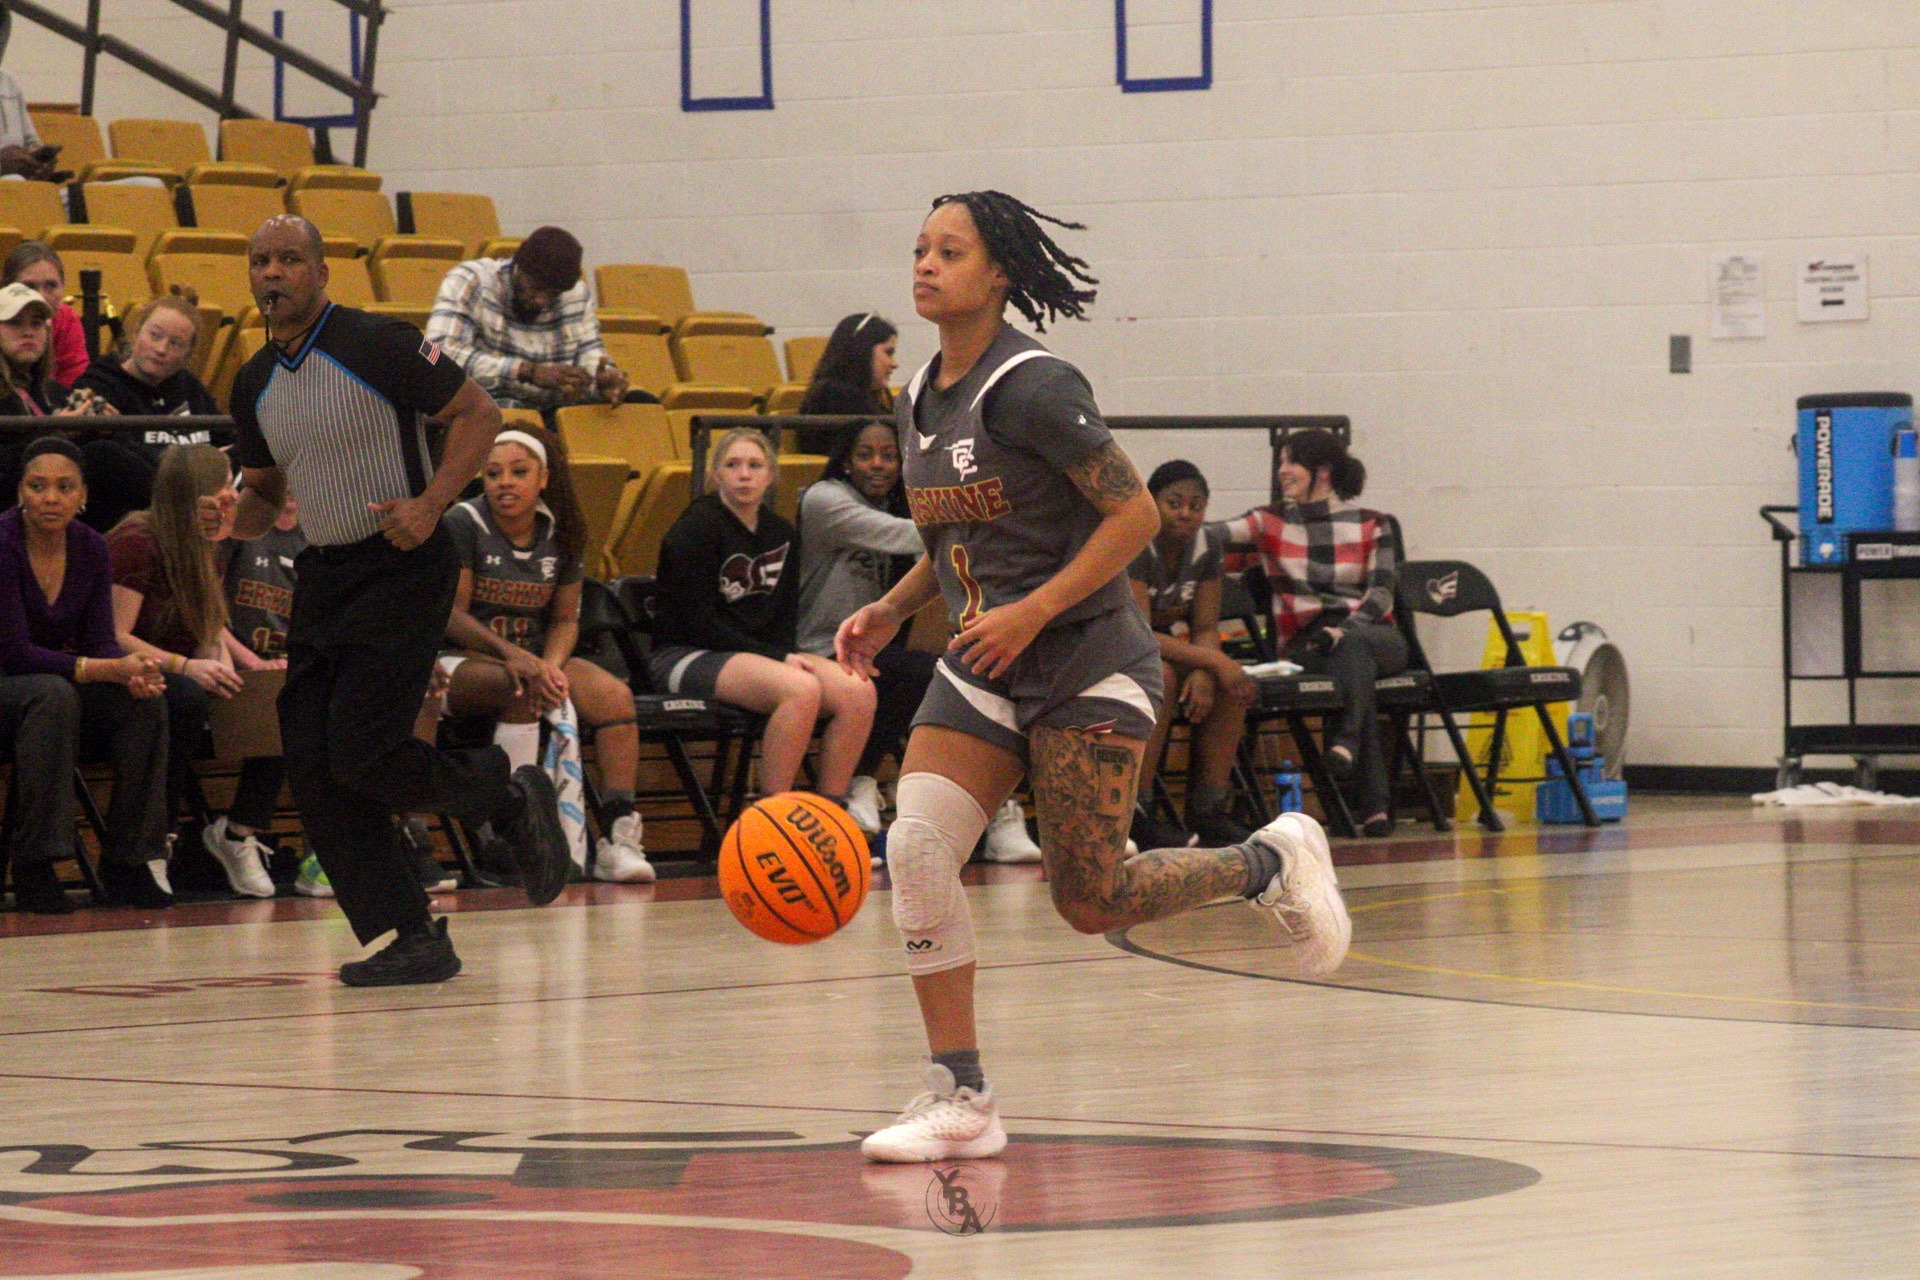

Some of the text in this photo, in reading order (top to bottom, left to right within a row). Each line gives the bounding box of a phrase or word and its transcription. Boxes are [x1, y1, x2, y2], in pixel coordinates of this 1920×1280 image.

[1817, 416, 1833, 518] POWERADE
[755, 851, 809, 904] EVO
[786, 804, 851, 899] Wilson
